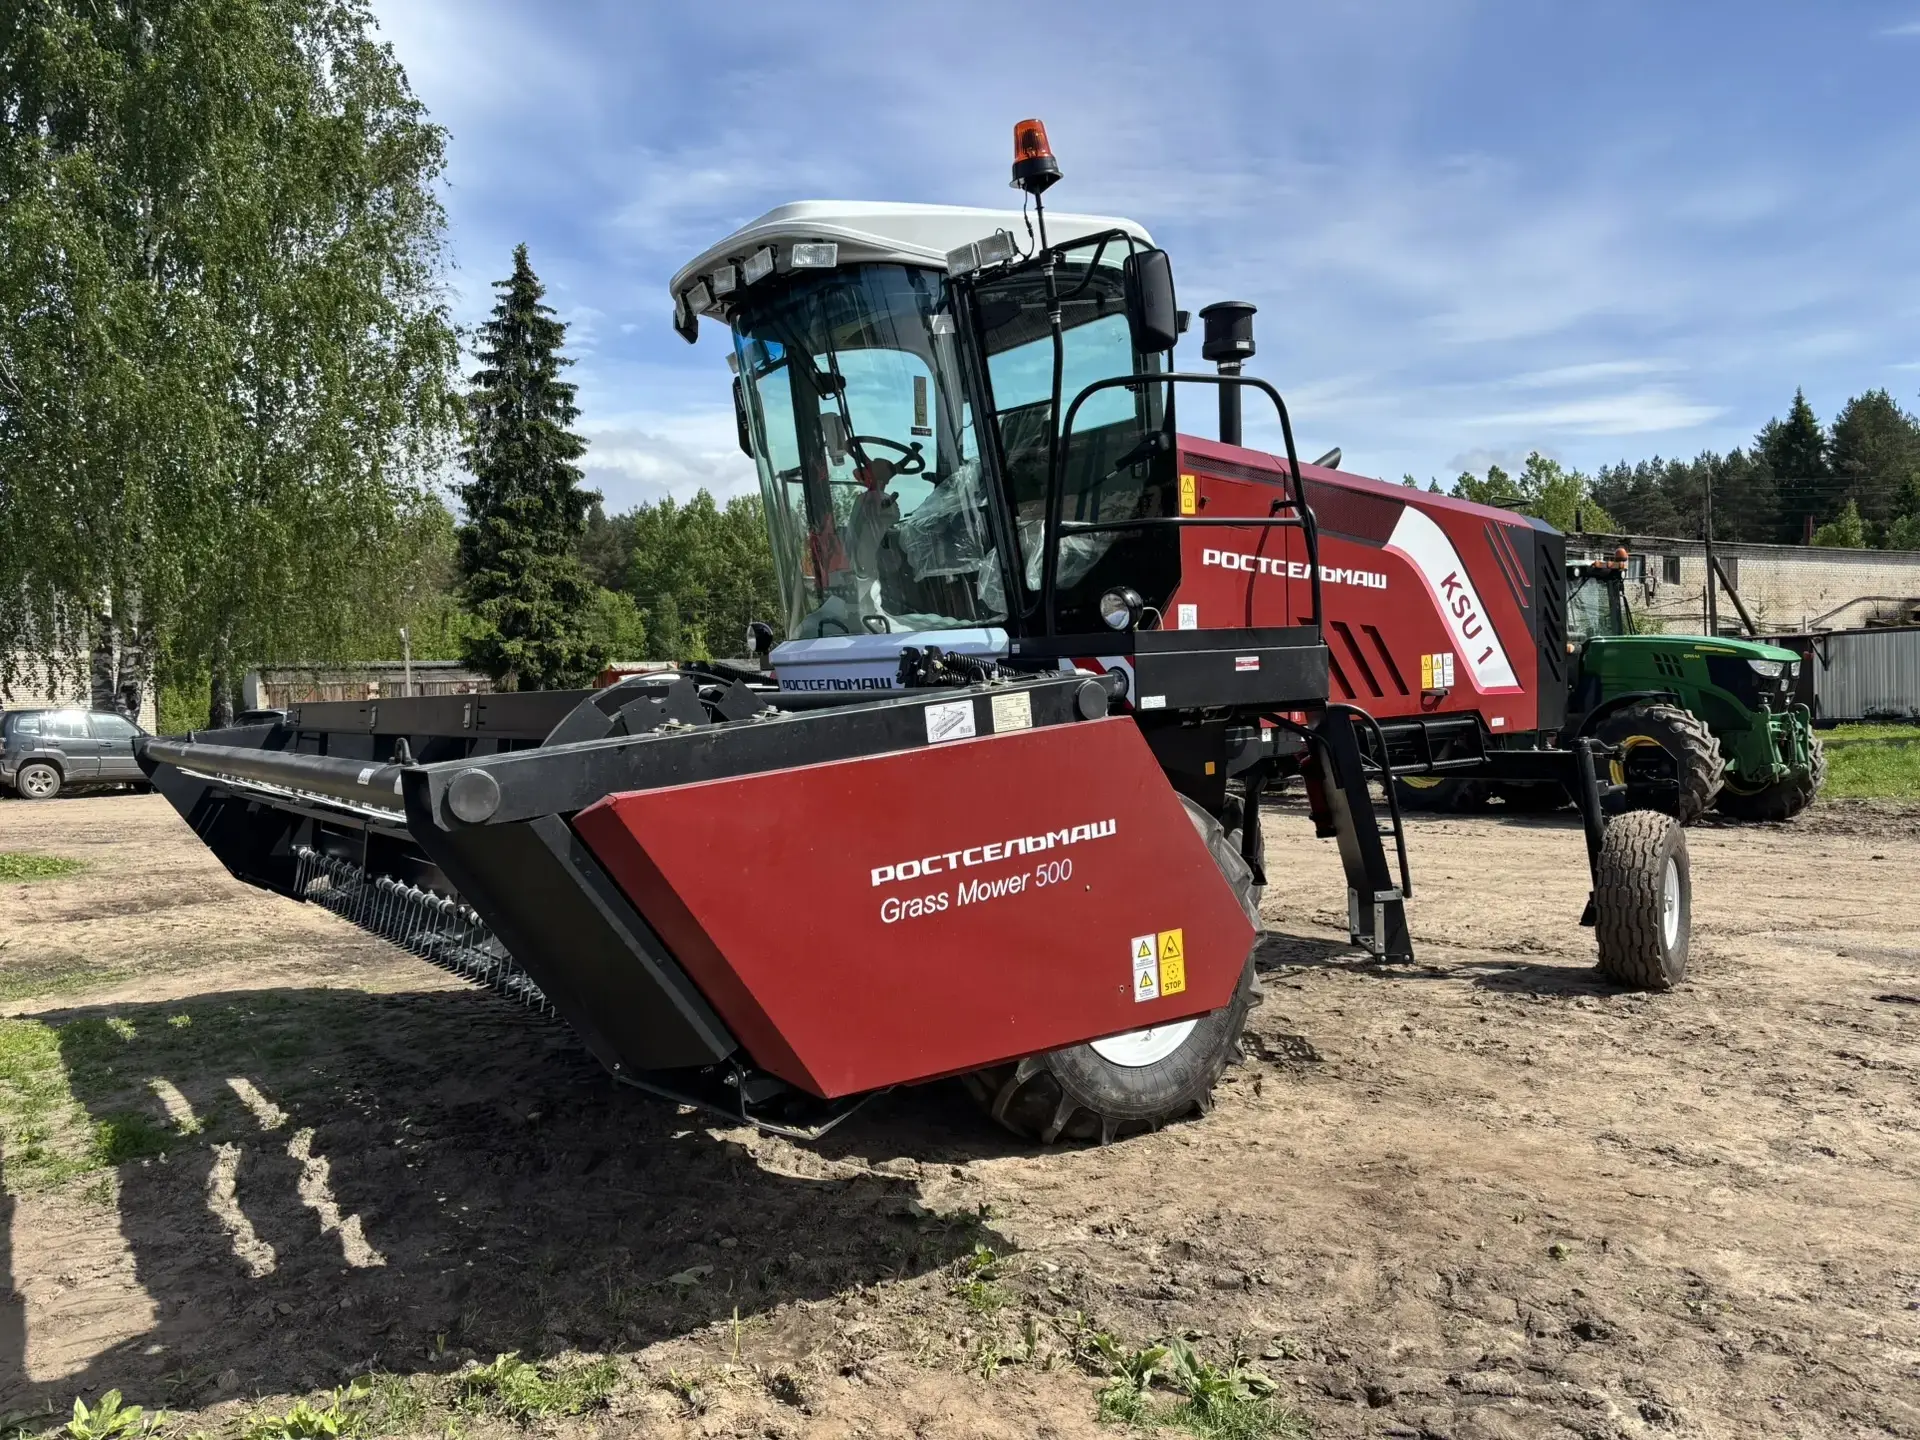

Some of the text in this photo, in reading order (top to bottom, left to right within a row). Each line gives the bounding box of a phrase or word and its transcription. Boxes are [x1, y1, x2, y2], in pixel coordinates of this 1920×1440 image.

[1440, 571, 1494, 665] KSU 1
[782, 677, 892, 691] РОСТСЕЛЬМАШ
[870, 818, 1117, 886] РОСТСЕЛЬМАШ
[880, 858, 1073, 924] Grass Mower 500
[1165, 980, 1182, 991] STOP
